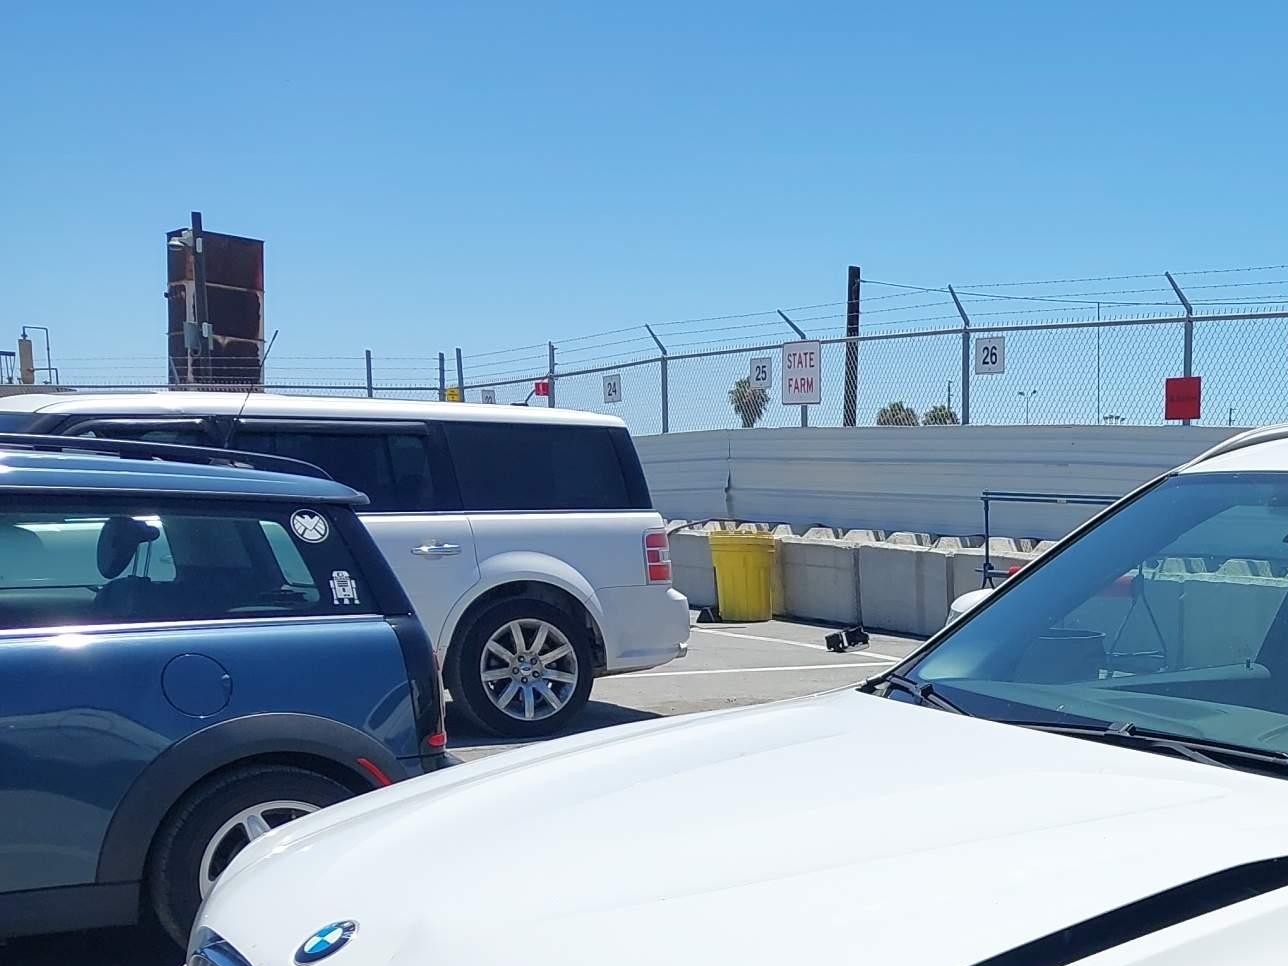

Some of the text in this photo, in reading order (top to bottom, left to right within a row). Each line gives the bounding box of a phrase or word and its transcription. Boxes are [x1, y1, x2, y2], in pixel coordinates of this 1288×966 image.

[787, 351, 815, 369] STATE
[982, 345, 998, 365] 26
[755, 365, 767, 382] 25
[607, 382, 617, 397] 24
[788, 377, 814, 394] FARM
